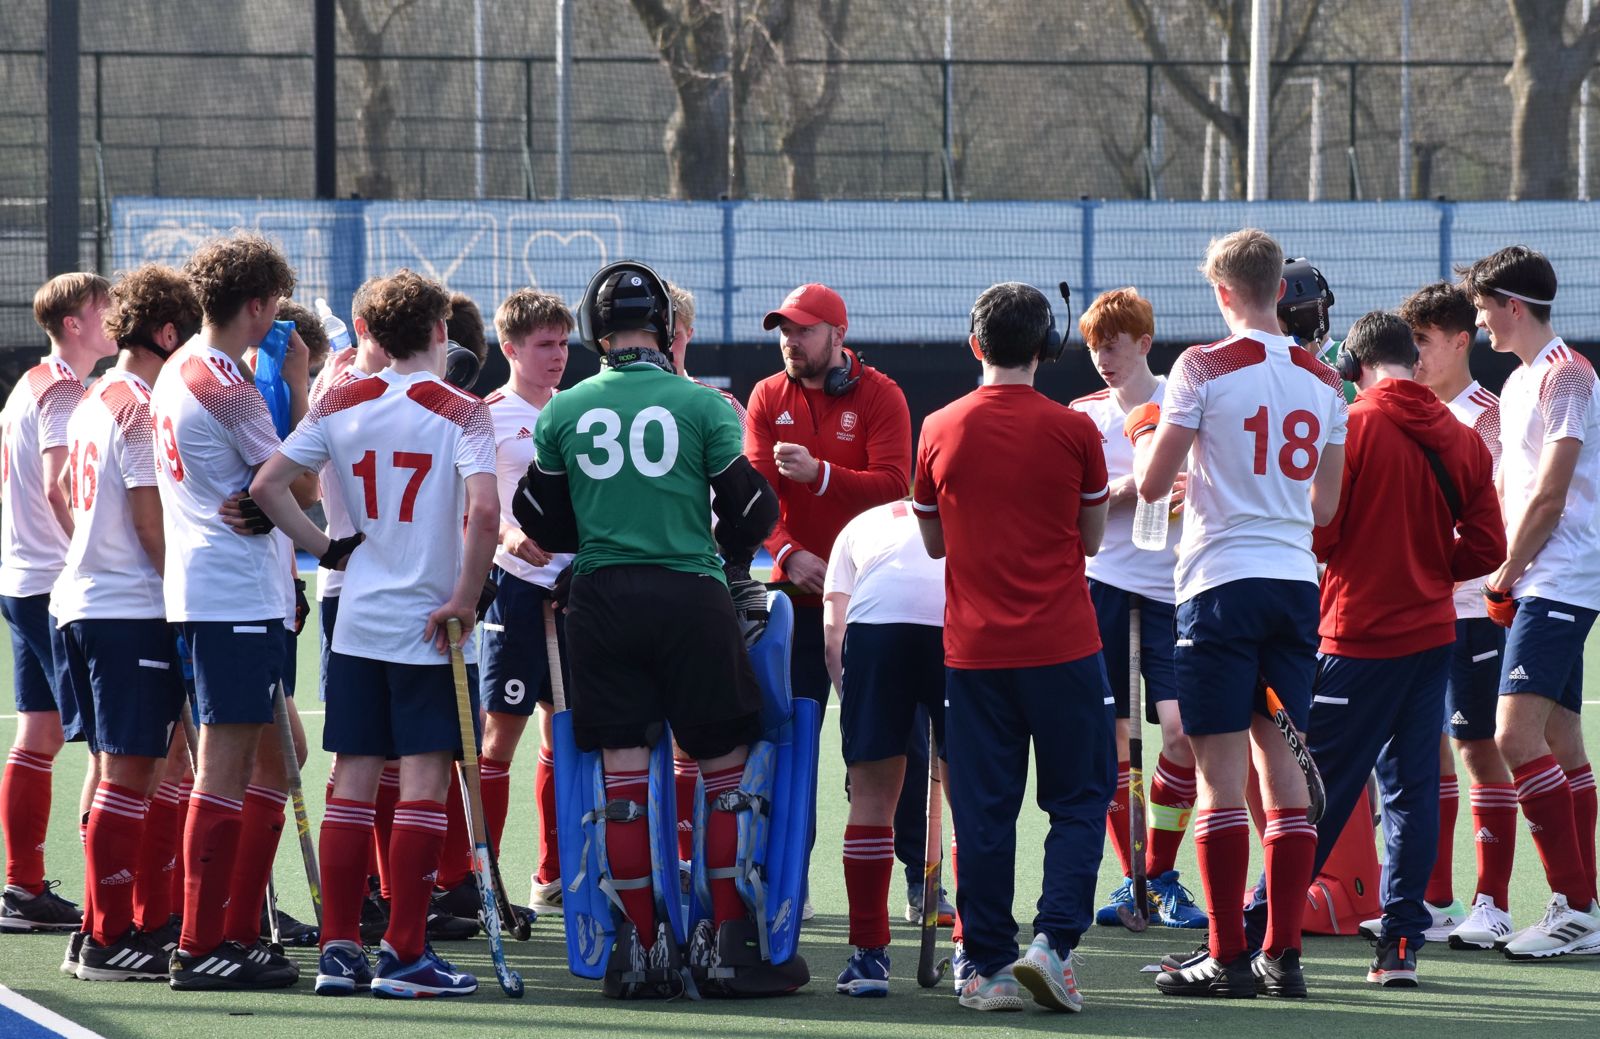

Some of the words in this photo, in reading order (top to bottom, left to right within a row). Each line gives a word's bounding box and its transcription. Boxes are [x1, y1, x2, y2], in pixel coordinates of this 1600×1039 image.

[69, 440, 98, 511] 16
[576, 405, 679, 480] 30
[1244, 406, 1320, 481] 18
[352, 450, 432, 522] 17
[503, 678, 526, 705] 9
